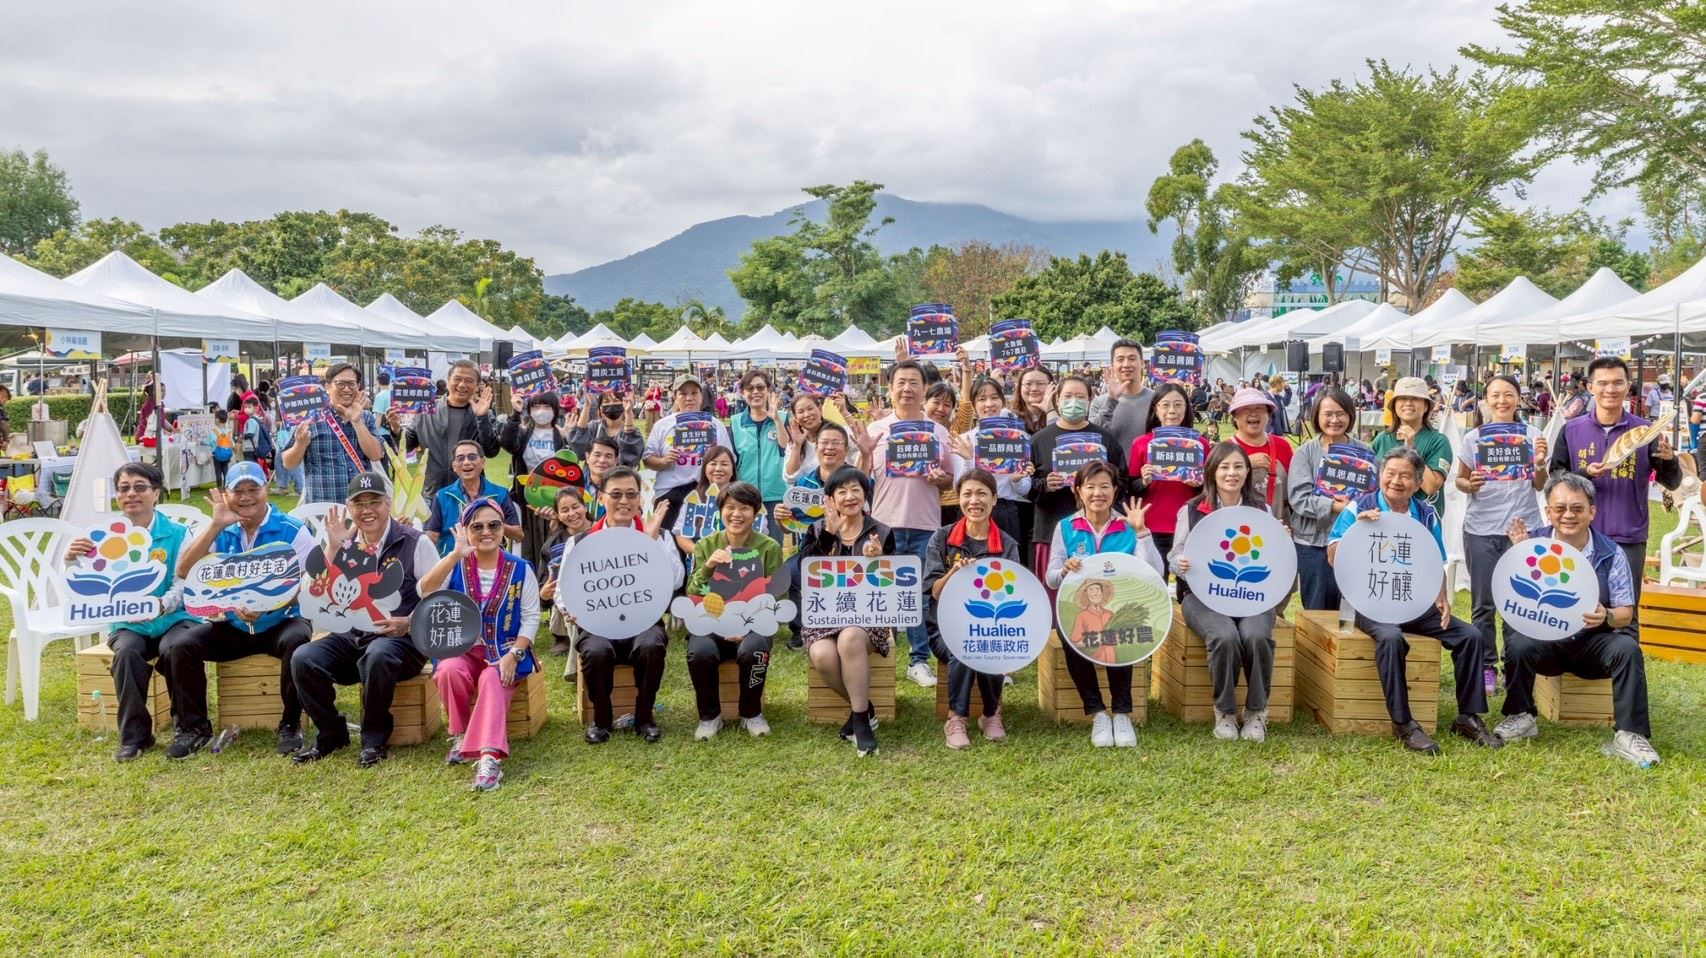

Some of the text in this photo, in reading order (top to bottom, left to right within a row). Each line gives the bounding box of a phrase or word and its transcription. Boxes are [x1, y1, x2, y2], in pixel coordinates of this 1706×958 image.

[912, 326, 952, 337] 九一七農場
[1155, 450, 1195, 463] 新味貿易
[1487, 446, 1521, 456] 美好食代
[1326, 466, 1369, 486] 無思農莊
[792, 491, 825, 505] 花蓮農
[1368, 531, 1413, 566] 花蓮
[200, 558, 286, 581] 花蓮農村好生活
[580, 552, 649, 575] HUALIEN
[807, 559, 918, 589] SDGs
[583, 573, 636, 593] GOOD
[1208, 582, 1265, 602] Hualien
[1368, 568, 1413, 602] 好釀
[70, 599, 154, 621] Hualien
[585, 589, 653, 612] SAUCES
[806, 591, 918, 613] 永續花蓮
[429, 601, 462, 625] 花蓮
[807, 614, 918, 625] Sustainable Hualien
[1504, 599, 1570, 632] Hualien
[429, 625, 463, 649] 好釀
[969, 623, 1026, 637] Hualien
[1081, 625, 1155, 648] 花蓮好農
[963, 639, 1030, 653] 花蓮縣政府
[749, 650, 769, 688] FILA
